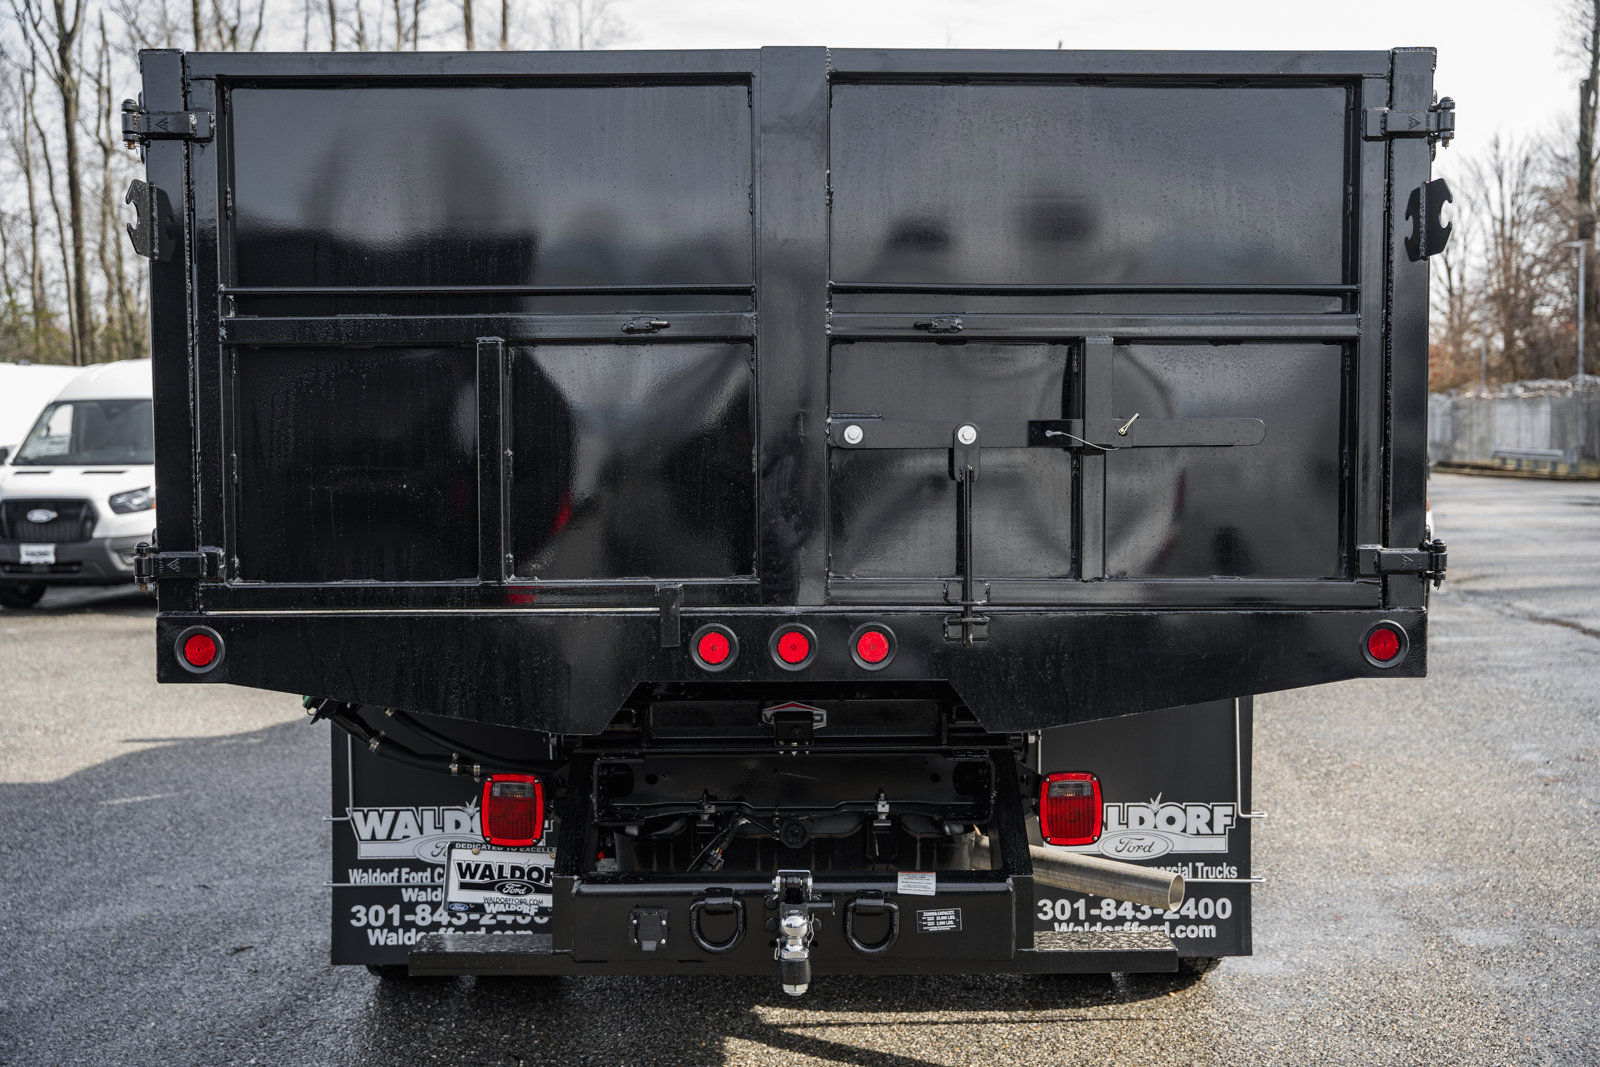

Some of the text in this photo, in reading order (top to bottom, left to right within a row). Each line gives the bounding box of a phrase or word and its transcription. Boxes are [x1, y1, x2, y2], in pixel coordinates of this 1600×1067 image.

[1104, 804, 1236, 835] LDORF
[455, 842, 504, 851] DEDICATED
[1115, 836, 1155, 853] Ford
[348, 867, 400, 884] Waldorf
[401, 867, 431, 884] Ford
[456, 862, 554, 885] WALDOR
[1195, 862, 1238, 879] Trucks
[401, 887, 443, 902] Wald
[502, 883, 527, 895] Ford
[484, 902, 539, 916] WALDORF
[1037, 898, 1233, 920] 301-843-2400
